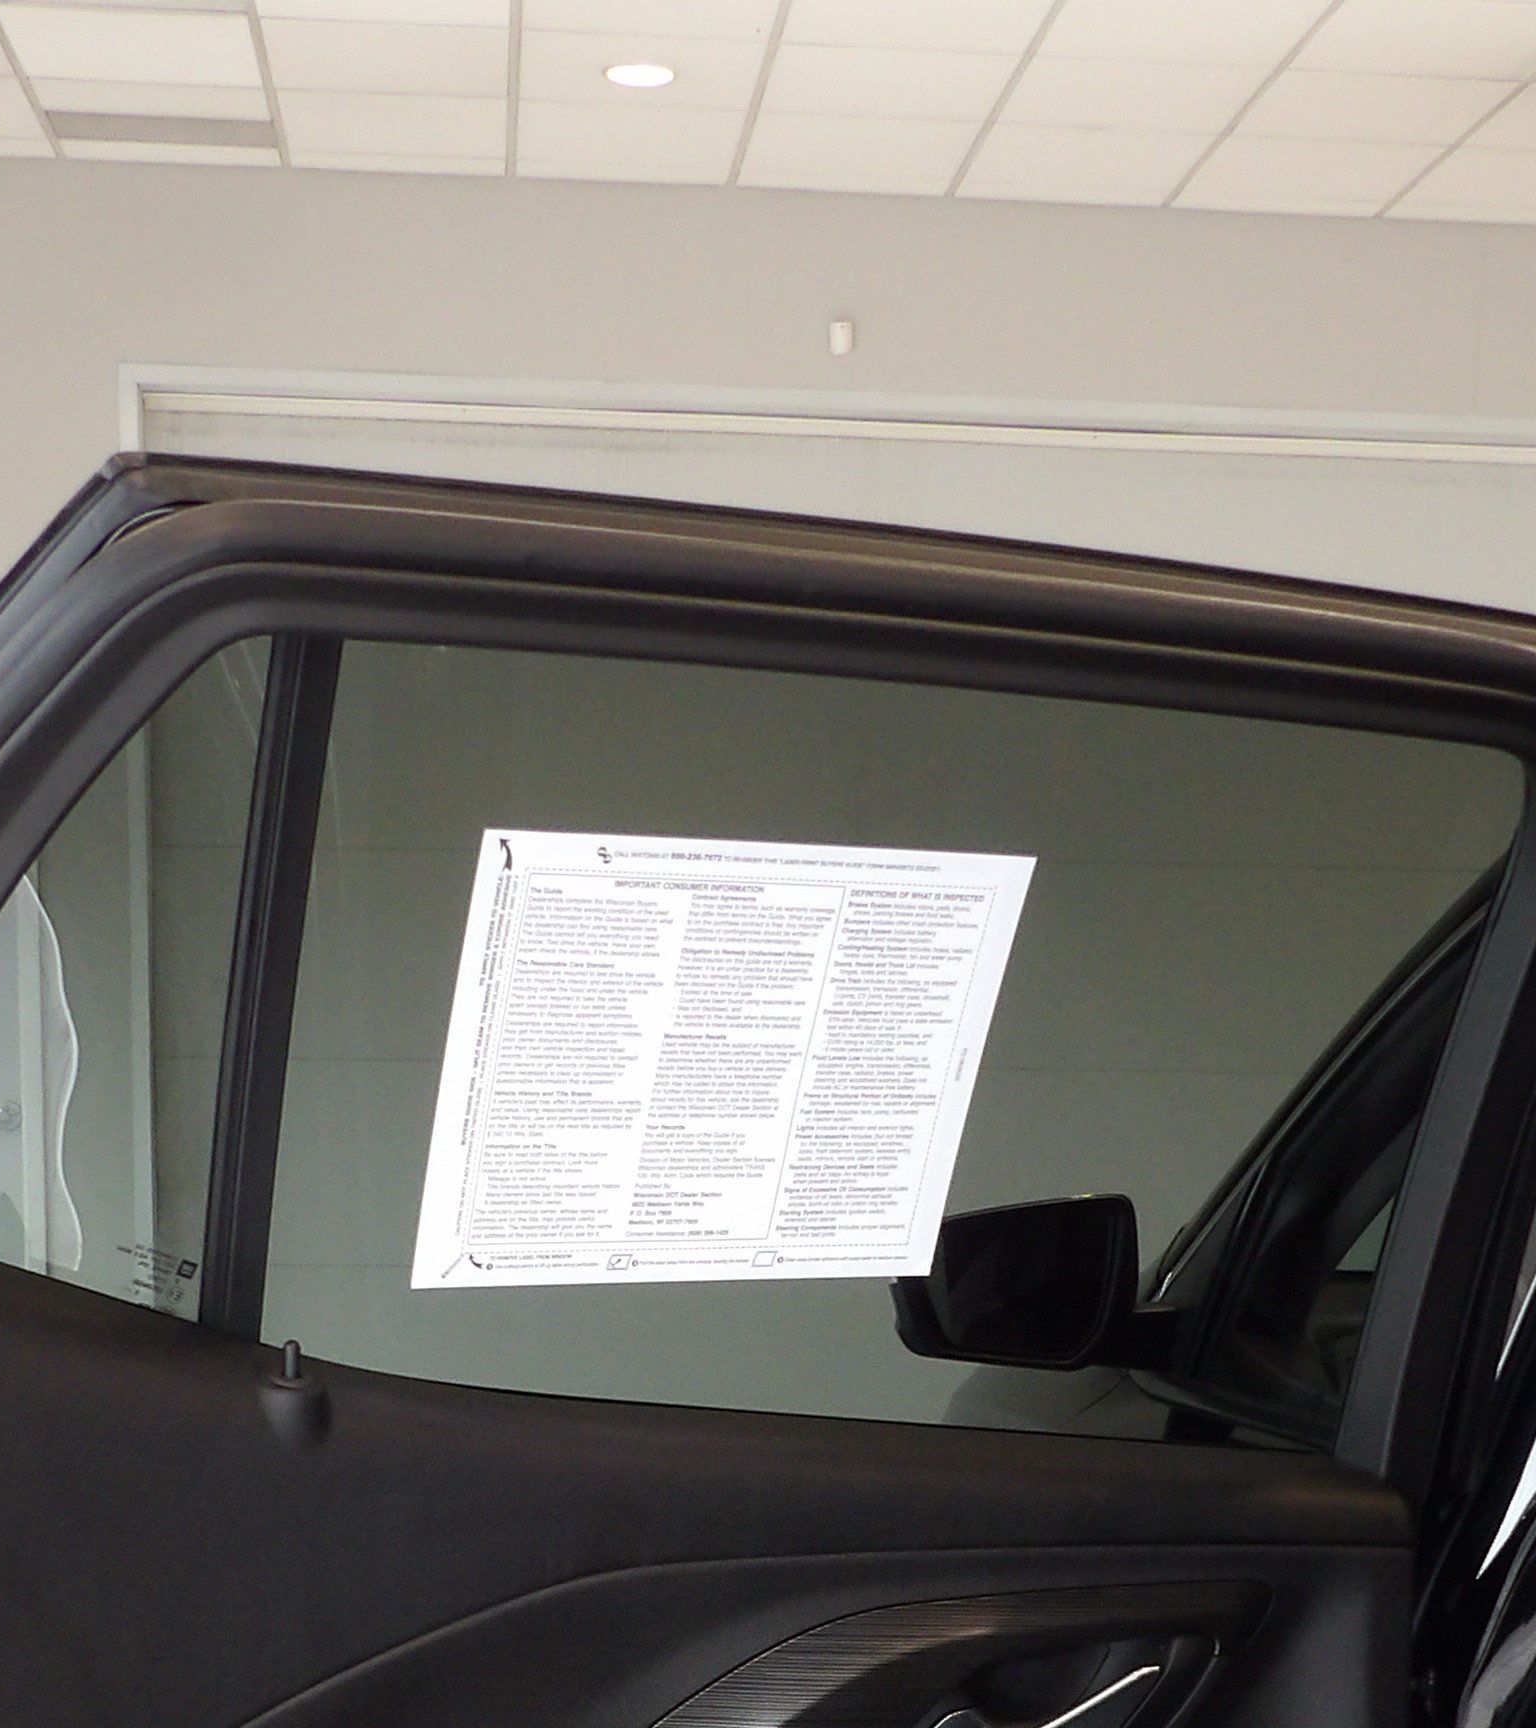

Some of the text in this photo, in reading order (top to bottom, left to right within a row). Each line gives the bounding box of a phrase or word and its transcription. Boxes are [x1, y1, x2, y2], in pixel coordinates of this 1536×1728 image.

[615, 879, 764, 893] IMPORTANT CONSUMER INFORMATION
[851, 889, 897, 898] DEFINITIONS
[943, 893, 985, 902] INSPECTED
